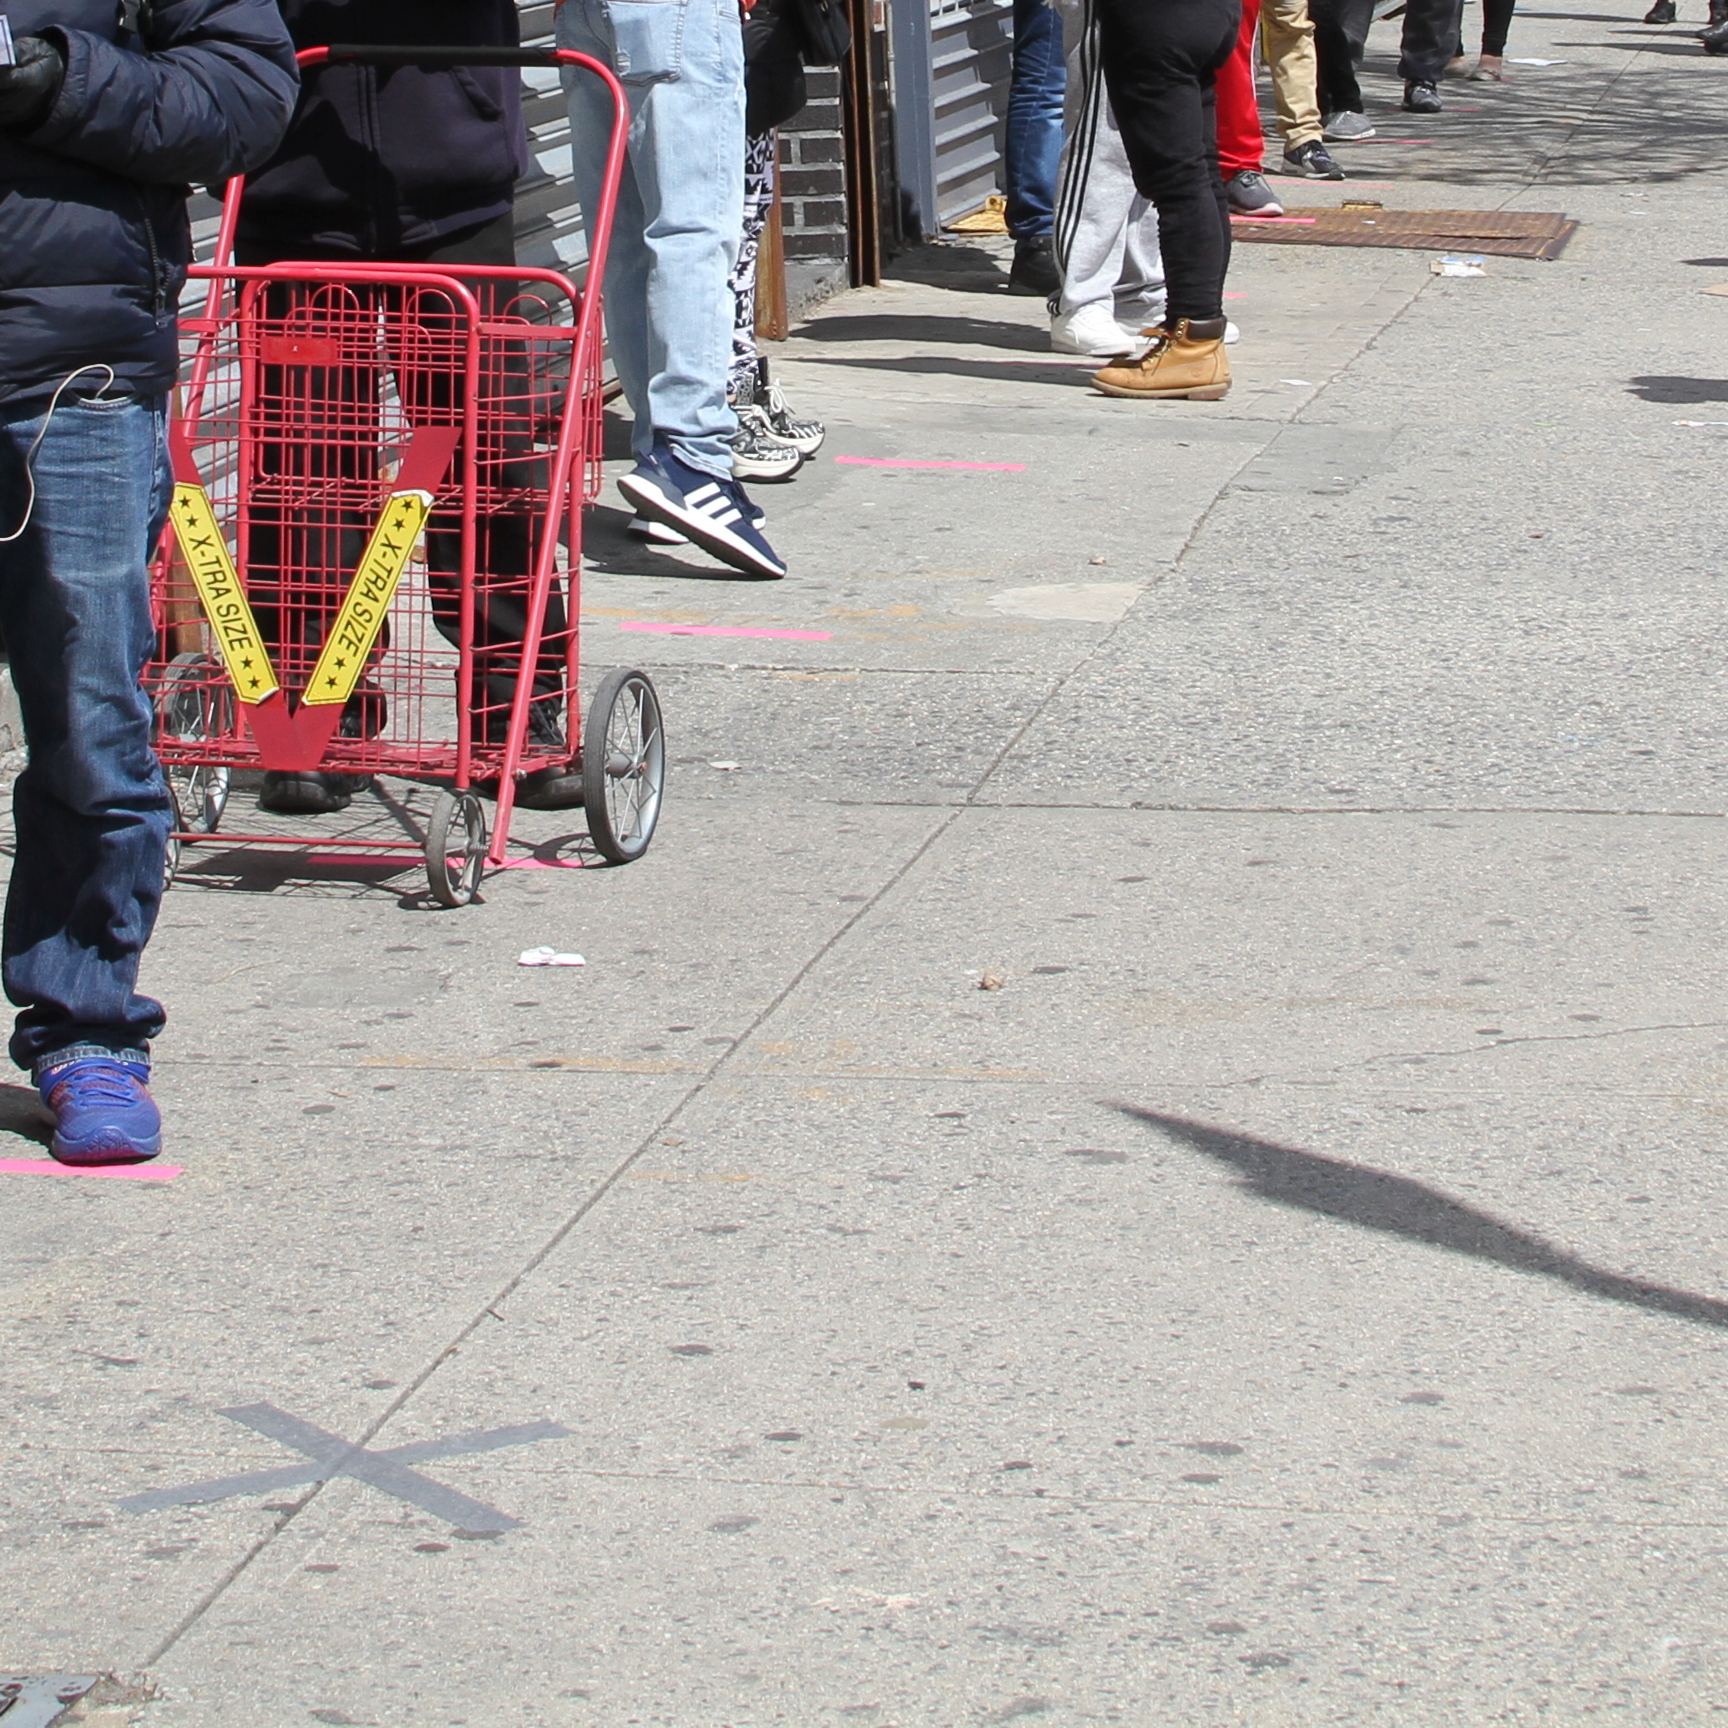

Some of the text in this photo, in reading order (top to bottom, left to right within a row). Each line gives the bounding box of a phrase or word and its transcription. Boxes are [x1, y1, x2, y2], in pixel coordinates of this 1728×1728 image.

[189, 534, 254, 652] X-TRA SIZE
[337, 533, 403, 658] X-TRA SIZE
